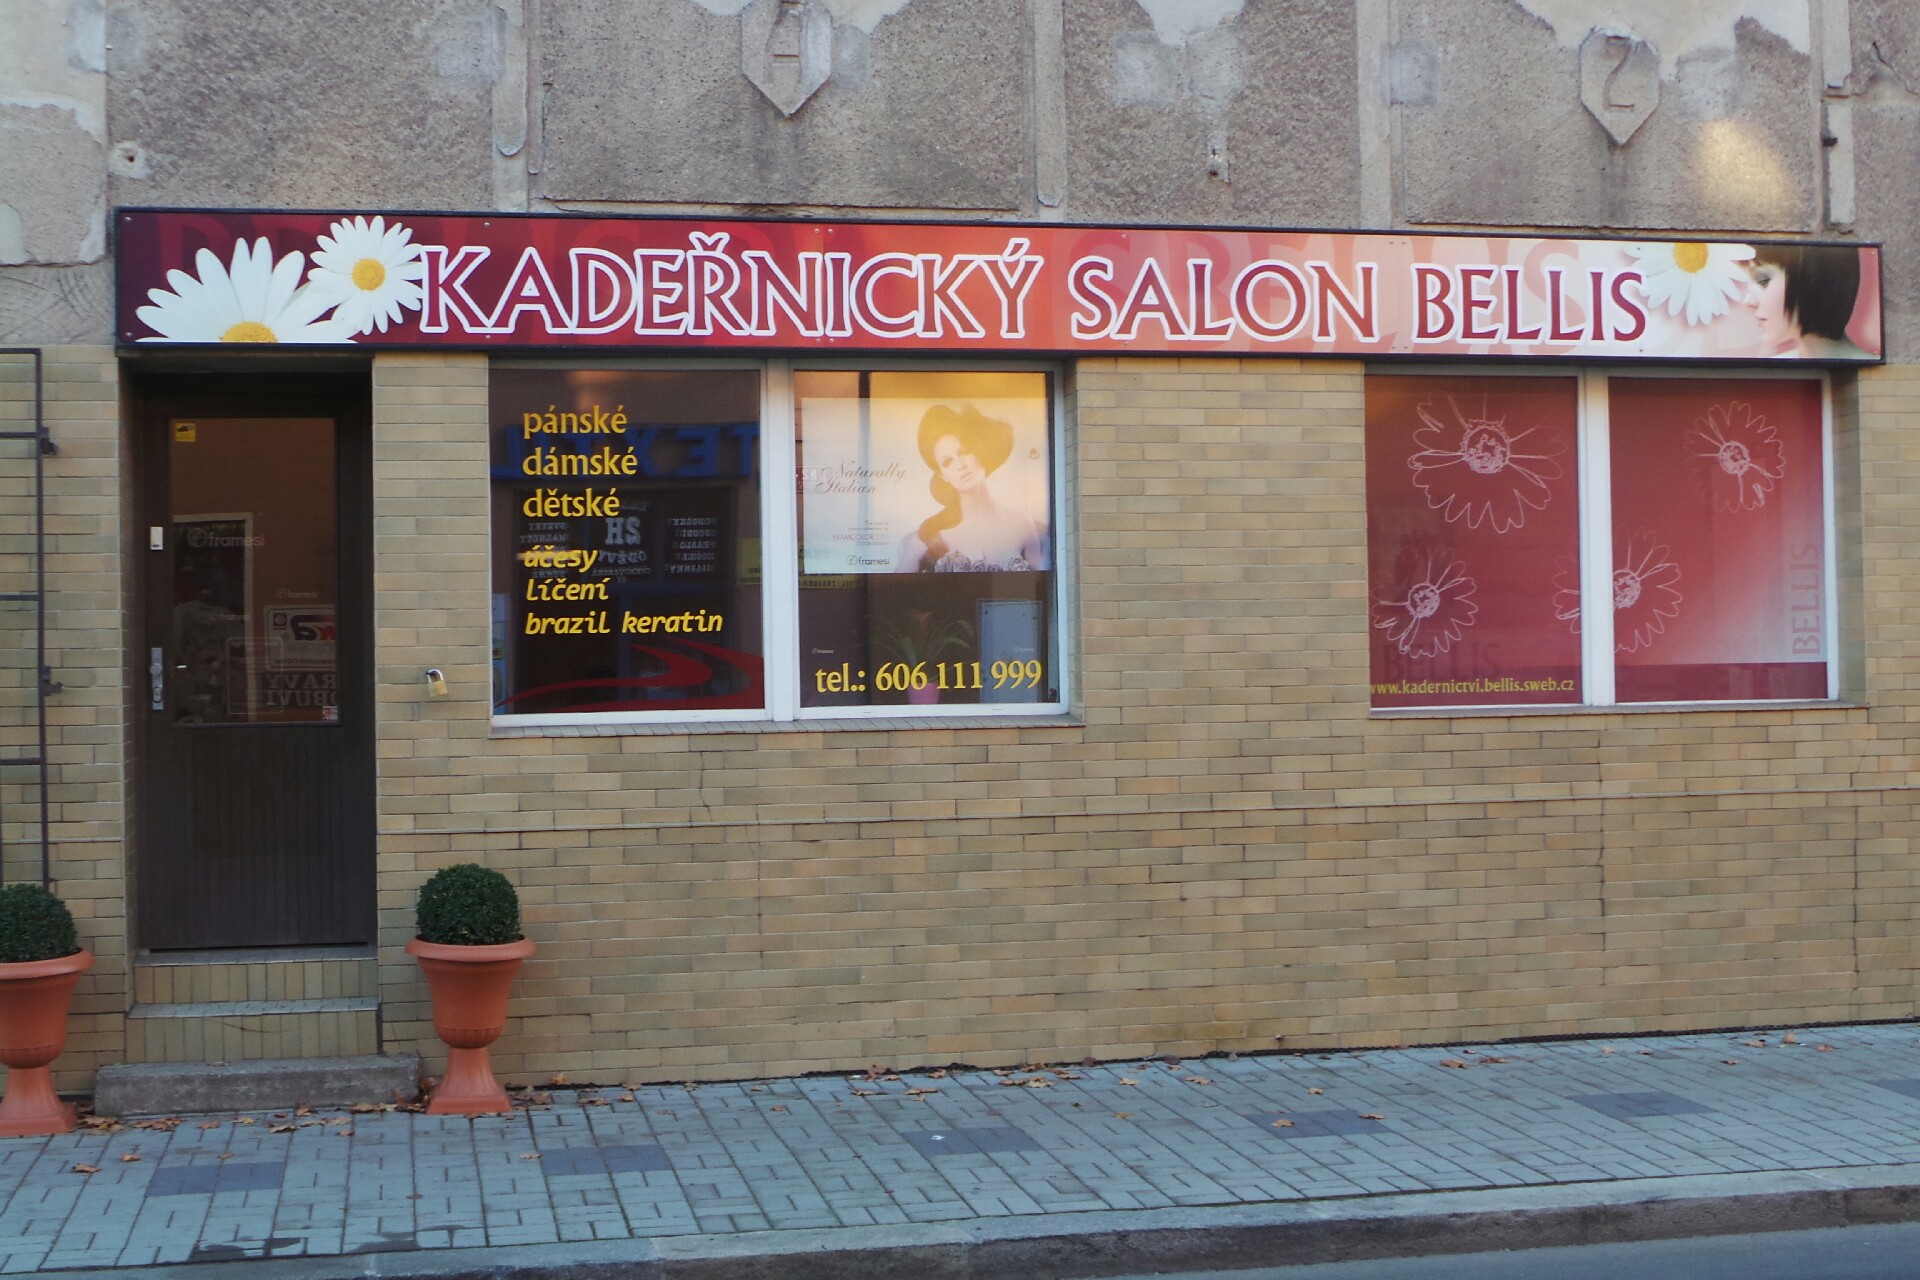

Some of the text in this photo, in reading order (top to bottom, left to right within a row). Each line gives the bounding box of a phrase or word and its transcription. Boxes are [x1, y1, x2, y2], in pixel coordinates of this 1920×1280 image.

[420, 231, 1651, 348] KADEŘNICKÝ SALON BELLIS
[523, 404, 628, 440] pánské
[522, 446, 639, 476] dámské
[820, 460, 906, 482] Naturally
[815, 479, 877, 494] Italian
[523, 487, 620, 518] dětské
[208, 532, 265, 547] framesi
[524, 544, 599, 573] účesy
[858, 556, 890, 566] framesi
[526, 578, 611, 601] líčení
[1790, 542, 1821, 655] BELLIS
[525, 608, 723, 635] brazil keratin
[815, 659, 1042, 693] tel.: 606 111 999
